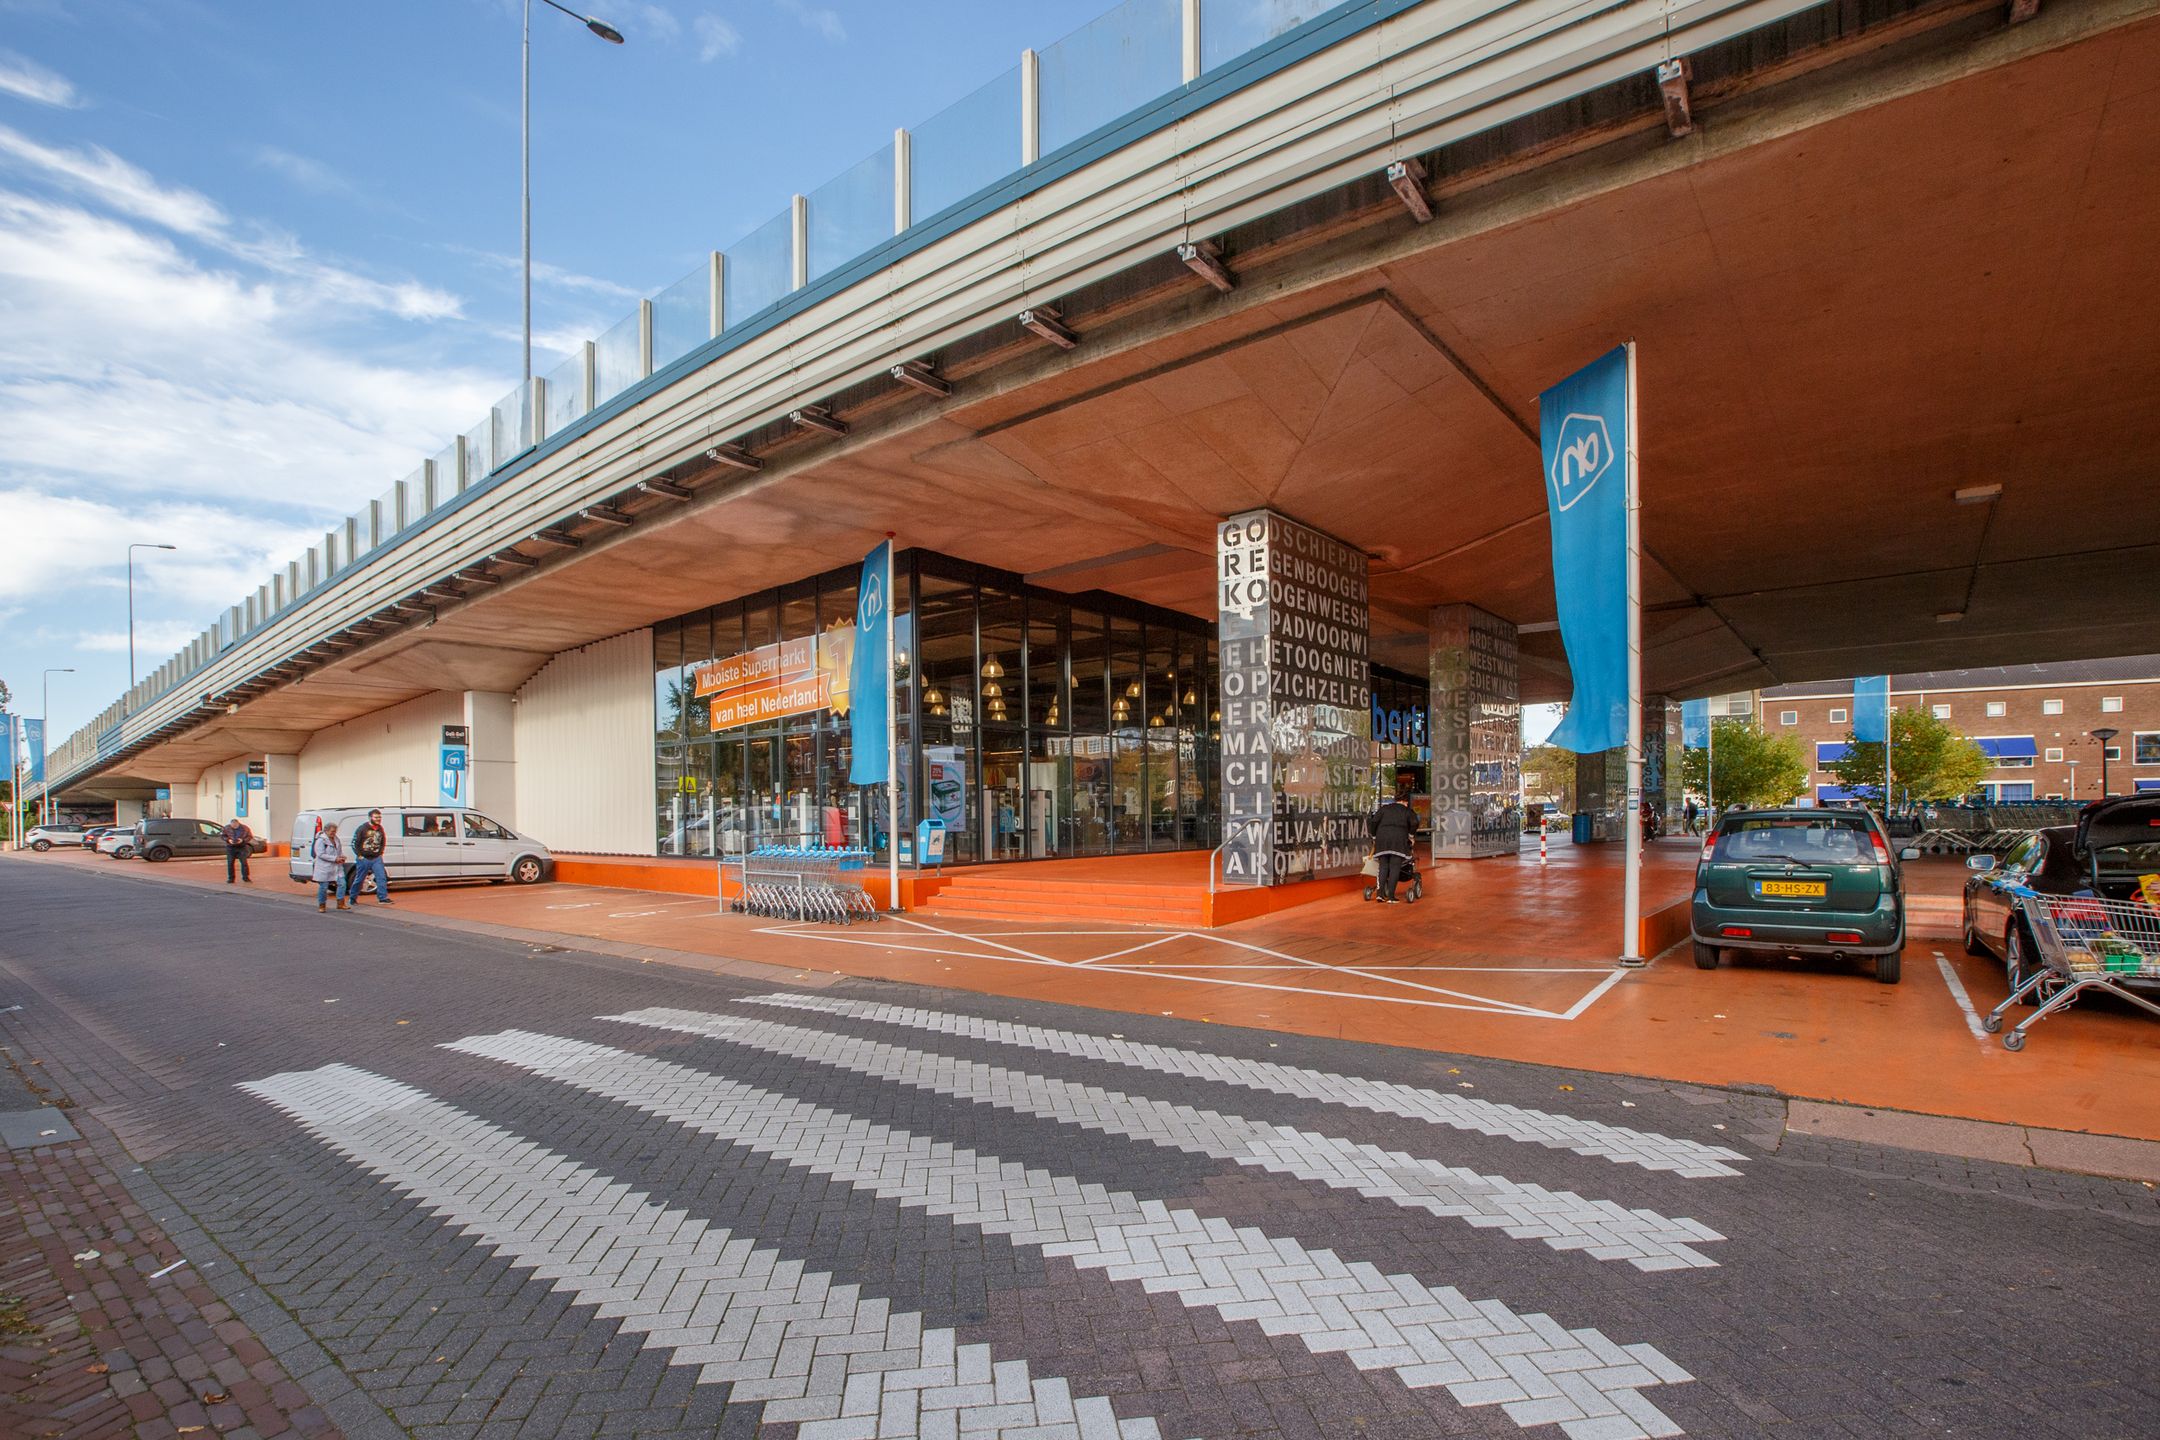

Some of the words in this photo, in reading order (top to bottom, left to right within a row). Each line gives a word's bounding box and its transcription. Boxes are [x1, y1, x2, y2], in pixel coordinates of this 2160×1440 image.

[1223, 519, 1266, 547] GO
[1270, 518, 1367, 577] DSCHIEPDE
[1224, 549, 1265, 577] RE
[1270, 551, 1367, 603] GENBOOGEN
[1224, 579, 1267, 607] KO
[1271, 580, 1368, 630] OGENWEESH
[1271, 609, 1368, 655] PADVOORWI
[702, 665, 739, 689] Mooiste
[742, 647, 806, 678] Supermarkt
[1271, 639, 1368, 681] ETOOGNIET
[1224, 670, 1267, 696] OP
[1271, 670, 1369, 708] ZICHZELFG
[715, 708, 734, 723] van
[736, 698, 758, 718] heel
[761, 684, 823, 714] Nederland!
[1227, 701, 1267, 726] ER
[1224, 731, 1268, 756] MA
[1226, 761, 1268, 785] CH
[1229, 792, 1262, 815] LI
[1436, 815, 1467, 832] RV
[1226, 851, 1268, 875] AR
[1766, 883, 1820, 893] 83-HS-ZX
